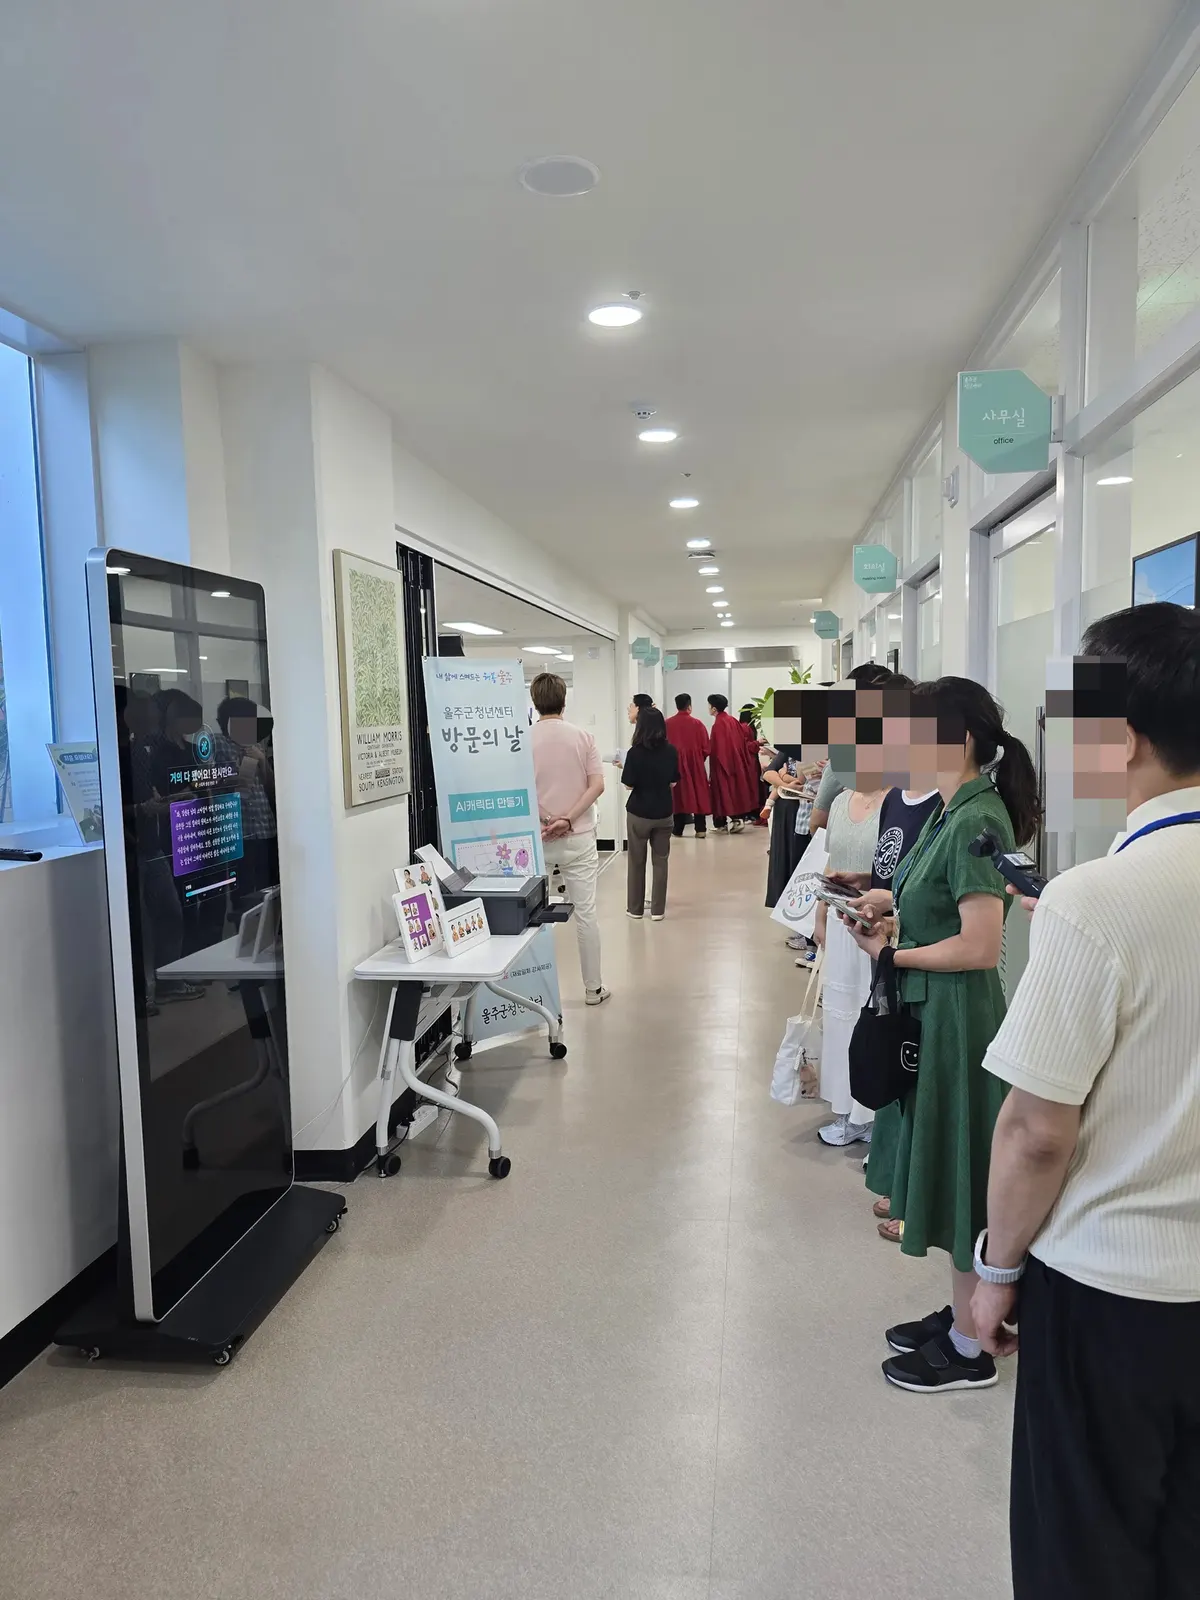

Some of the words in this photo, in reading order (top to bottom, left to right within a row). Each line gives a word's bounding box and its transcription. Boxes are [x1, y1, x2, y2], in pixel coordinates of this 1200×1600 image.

[982, 407, 1025, 428] 사무실
[993, 437, 1014, 445] office
[443, 706, 514, 720] 울주군청년센터
[356, 732, 381, 745] WILLIAM
[383, 730, 403, 742] MORRIS
[441, 726, 499, 754] 방문의
[503, 725, 524, 753] 날
[170, 771, 183, 784] 거의
[184, 770, 190, 783] 다
[358, 780, 375, 792] SOUTH
[377, 775, 405, 788] KENSINGTON
[455, 798, 495, 813] AI캐릭터
[497, 796, 524, 809] 만들기
